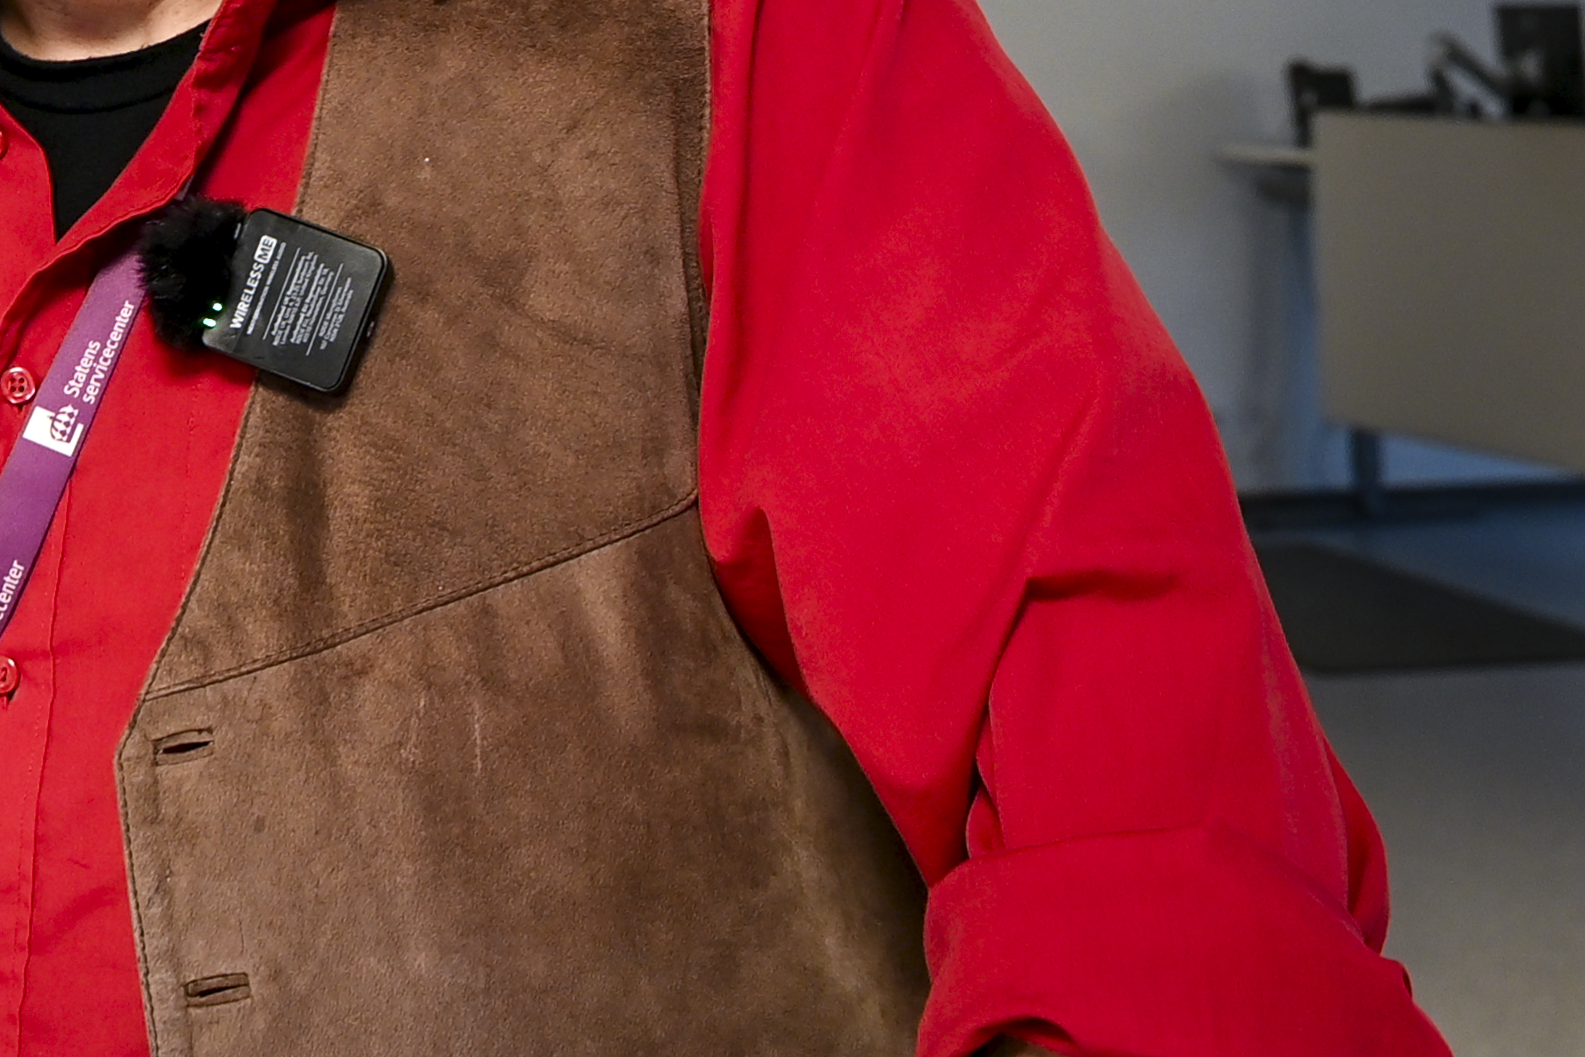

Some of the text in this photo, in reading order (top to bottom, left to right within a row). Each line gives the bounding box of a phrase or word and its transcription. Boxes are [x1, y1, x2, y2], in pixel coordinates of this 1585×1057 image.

[229, 262, 265, 329] WIRELESS
[256, 237, 276, 262] ME
[63, 340, 101, 398] Statens
[82, 300, 135, 405] servicecenter
